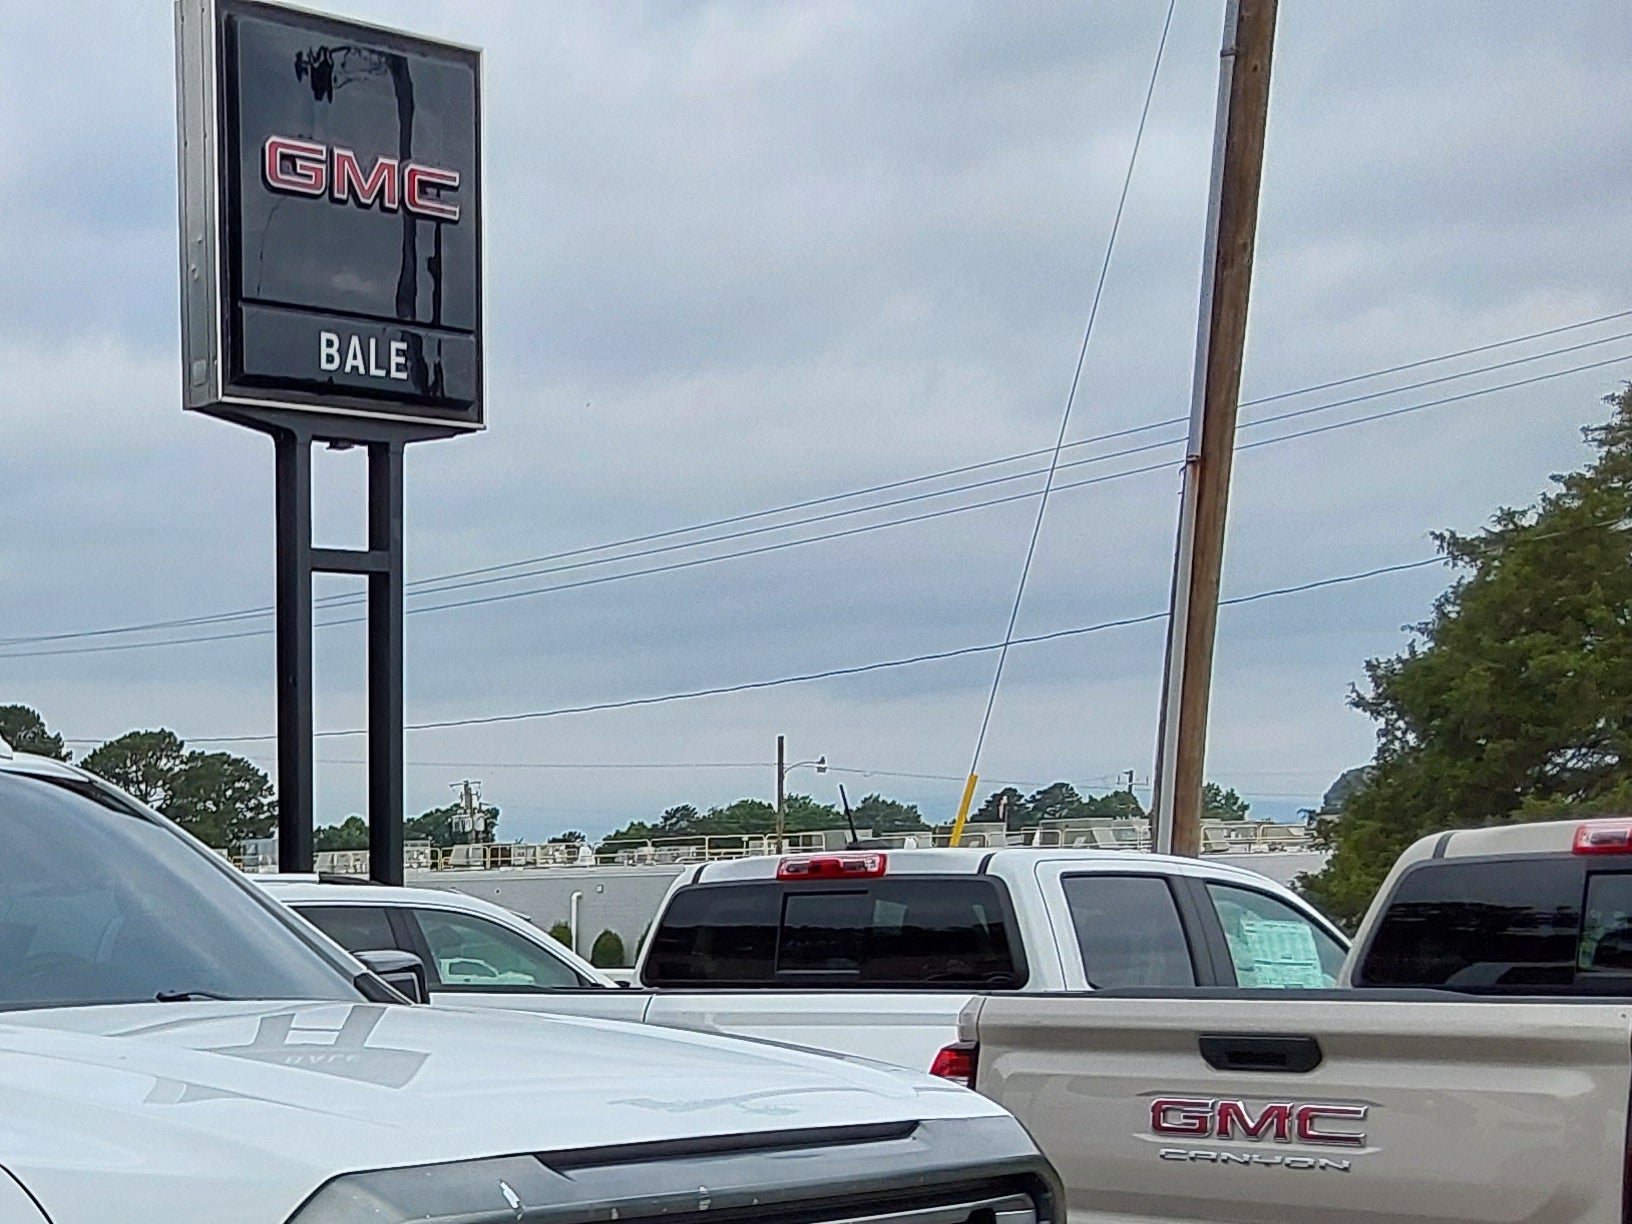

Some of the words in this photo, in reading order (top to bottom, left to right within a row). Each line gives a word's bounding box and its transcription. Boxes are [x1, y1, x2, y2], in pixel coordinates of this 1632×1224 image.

[265, 136, 460, 220] GMC
[320, 331, 408, 380] BALE
[1150, 1097, 1368, 1147] GMC
[1159, 1148, 1352, 1172] CANYON
